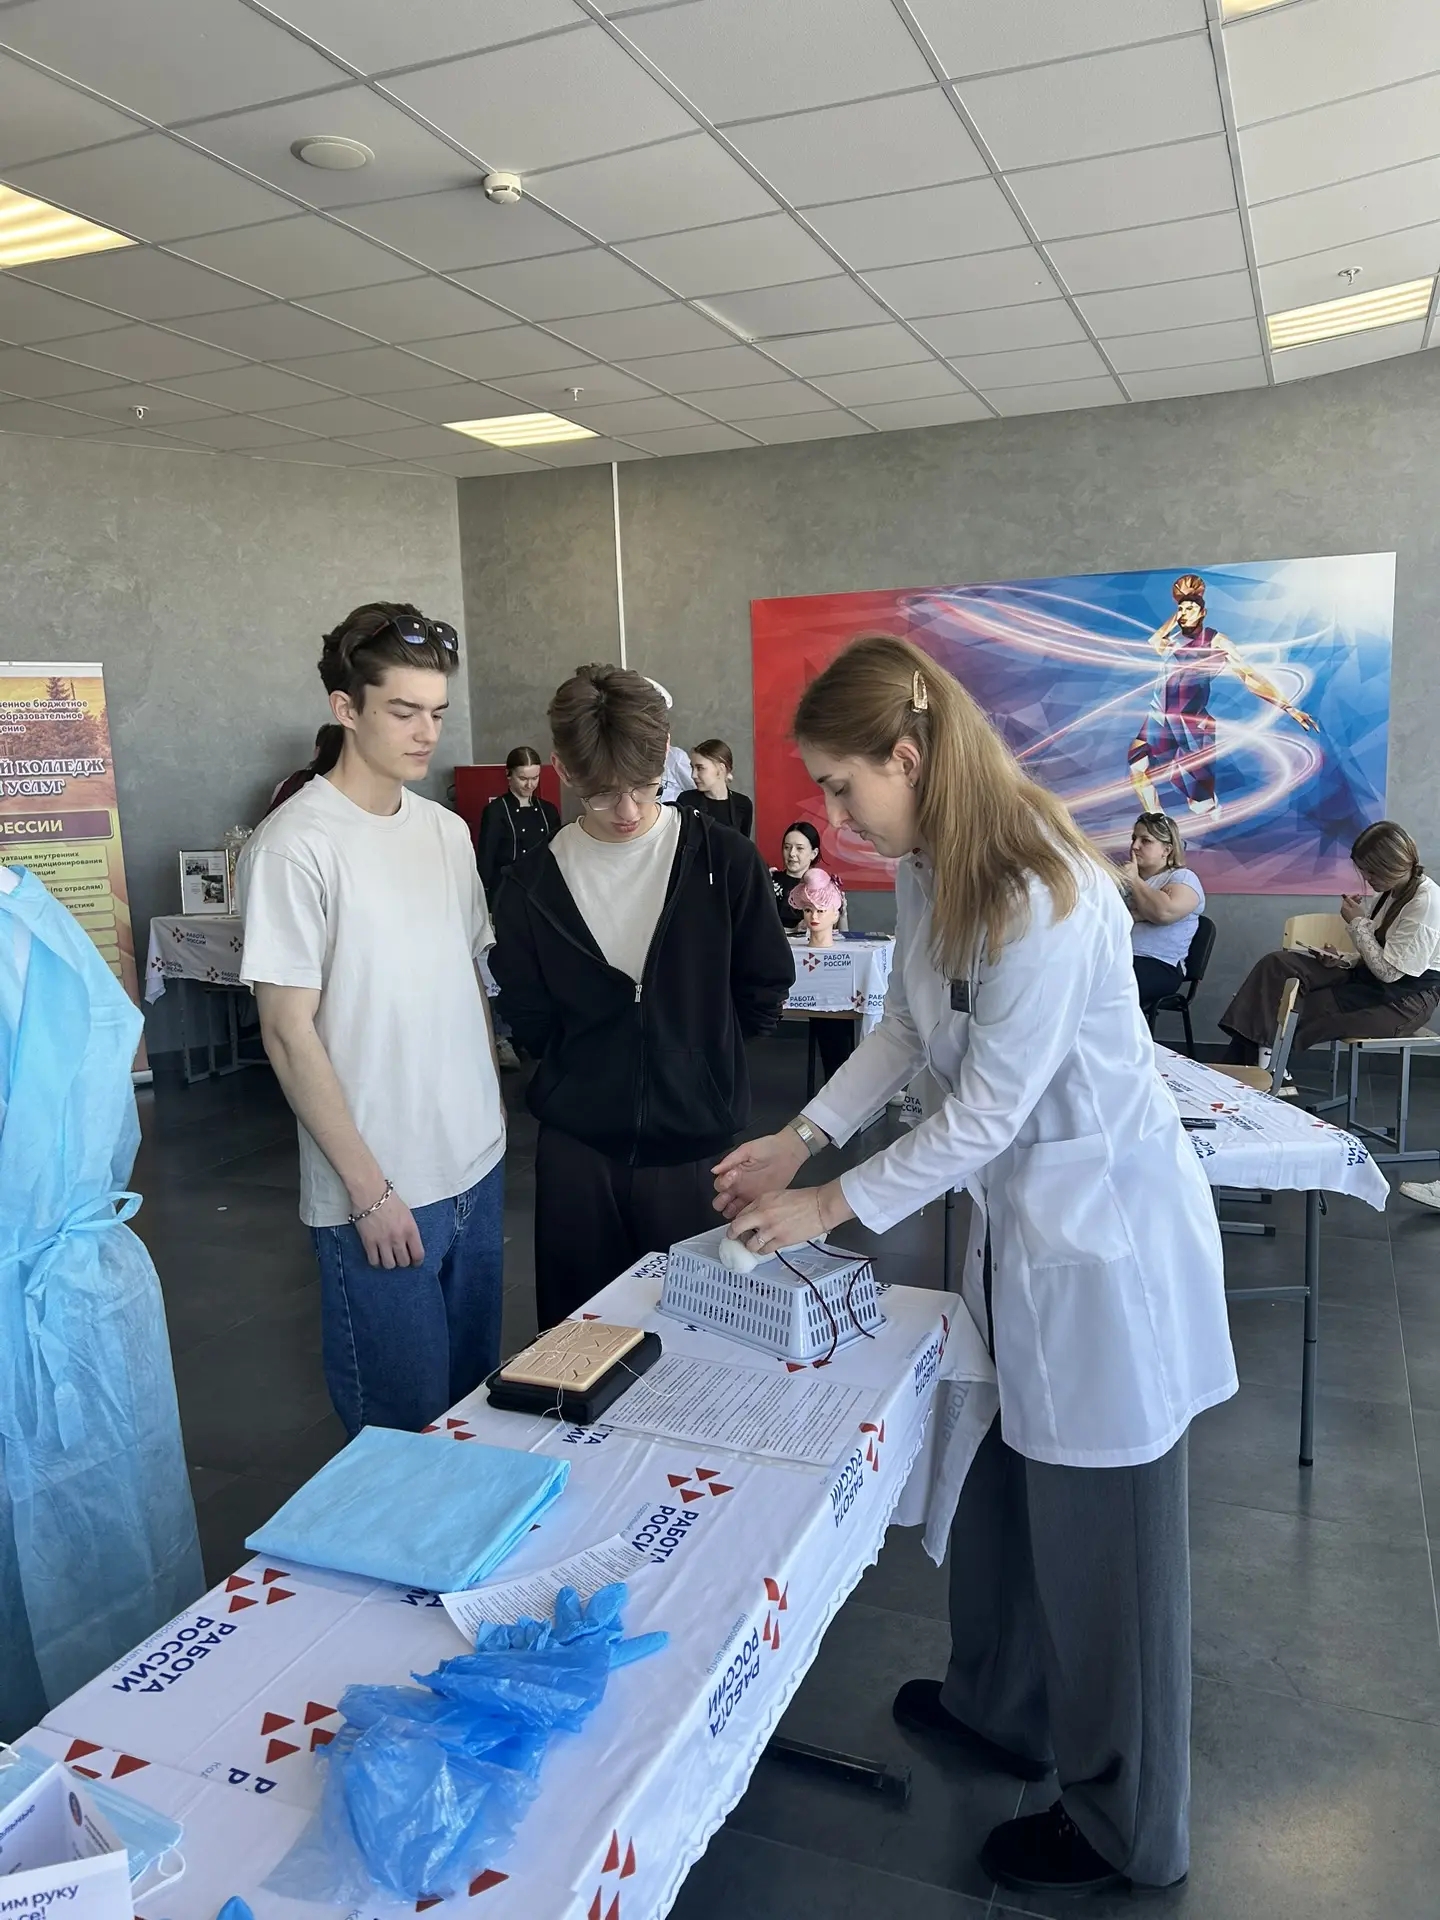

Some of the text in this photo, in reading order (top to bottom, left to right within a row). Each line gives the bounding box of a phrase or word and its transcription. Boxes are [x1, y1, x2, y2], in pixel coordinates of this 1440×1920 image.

[33, 700, 88, 709] бюджетное
[0, 725, 26, 734] ение
[17, 759, 105, 775] КОЛЛЕДЖ
[7, 780, 64, 795] УСЛУГ
[34, 852, 79, 860] внутренних
[64, 883, 104, 892] отраслям)
[823, 954, 851, 962] РАБОТА
[830, 1448, 863, 1511] РОССИИ
[111, 1616, 215, 1693] РОССИИ
[138, 1622, 238, 1693] РАБОТА
[708, 1626, 760, 1720] РОССИИ
[709, 1654, 760, 1739] РАБОТА
[32, 1884, 79, 1908] руку
